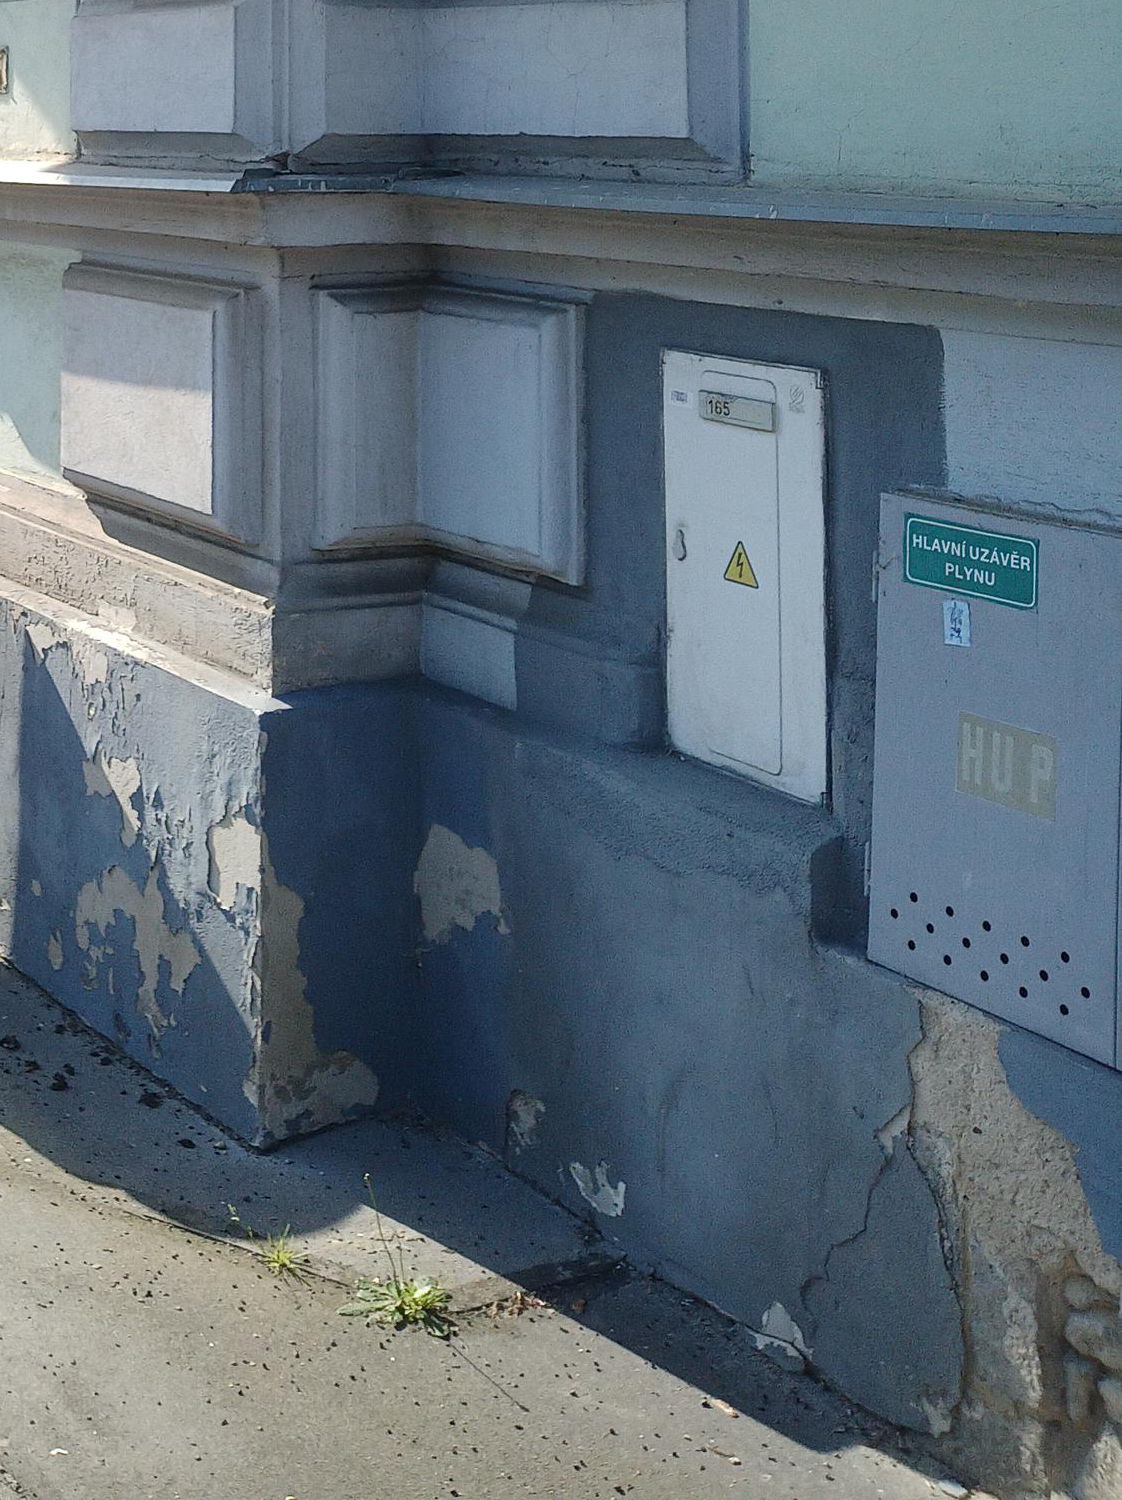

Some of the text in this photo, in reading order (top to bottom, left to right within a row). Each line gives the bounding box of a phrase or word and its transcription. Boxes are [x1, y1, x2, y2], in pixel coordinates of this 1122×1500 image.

[708, 399, 731, 416] 165
[912, 533, 1031, 572] HLAVNÍ UZÁVĚR
[945, 562, 996, 586] PLYNU
